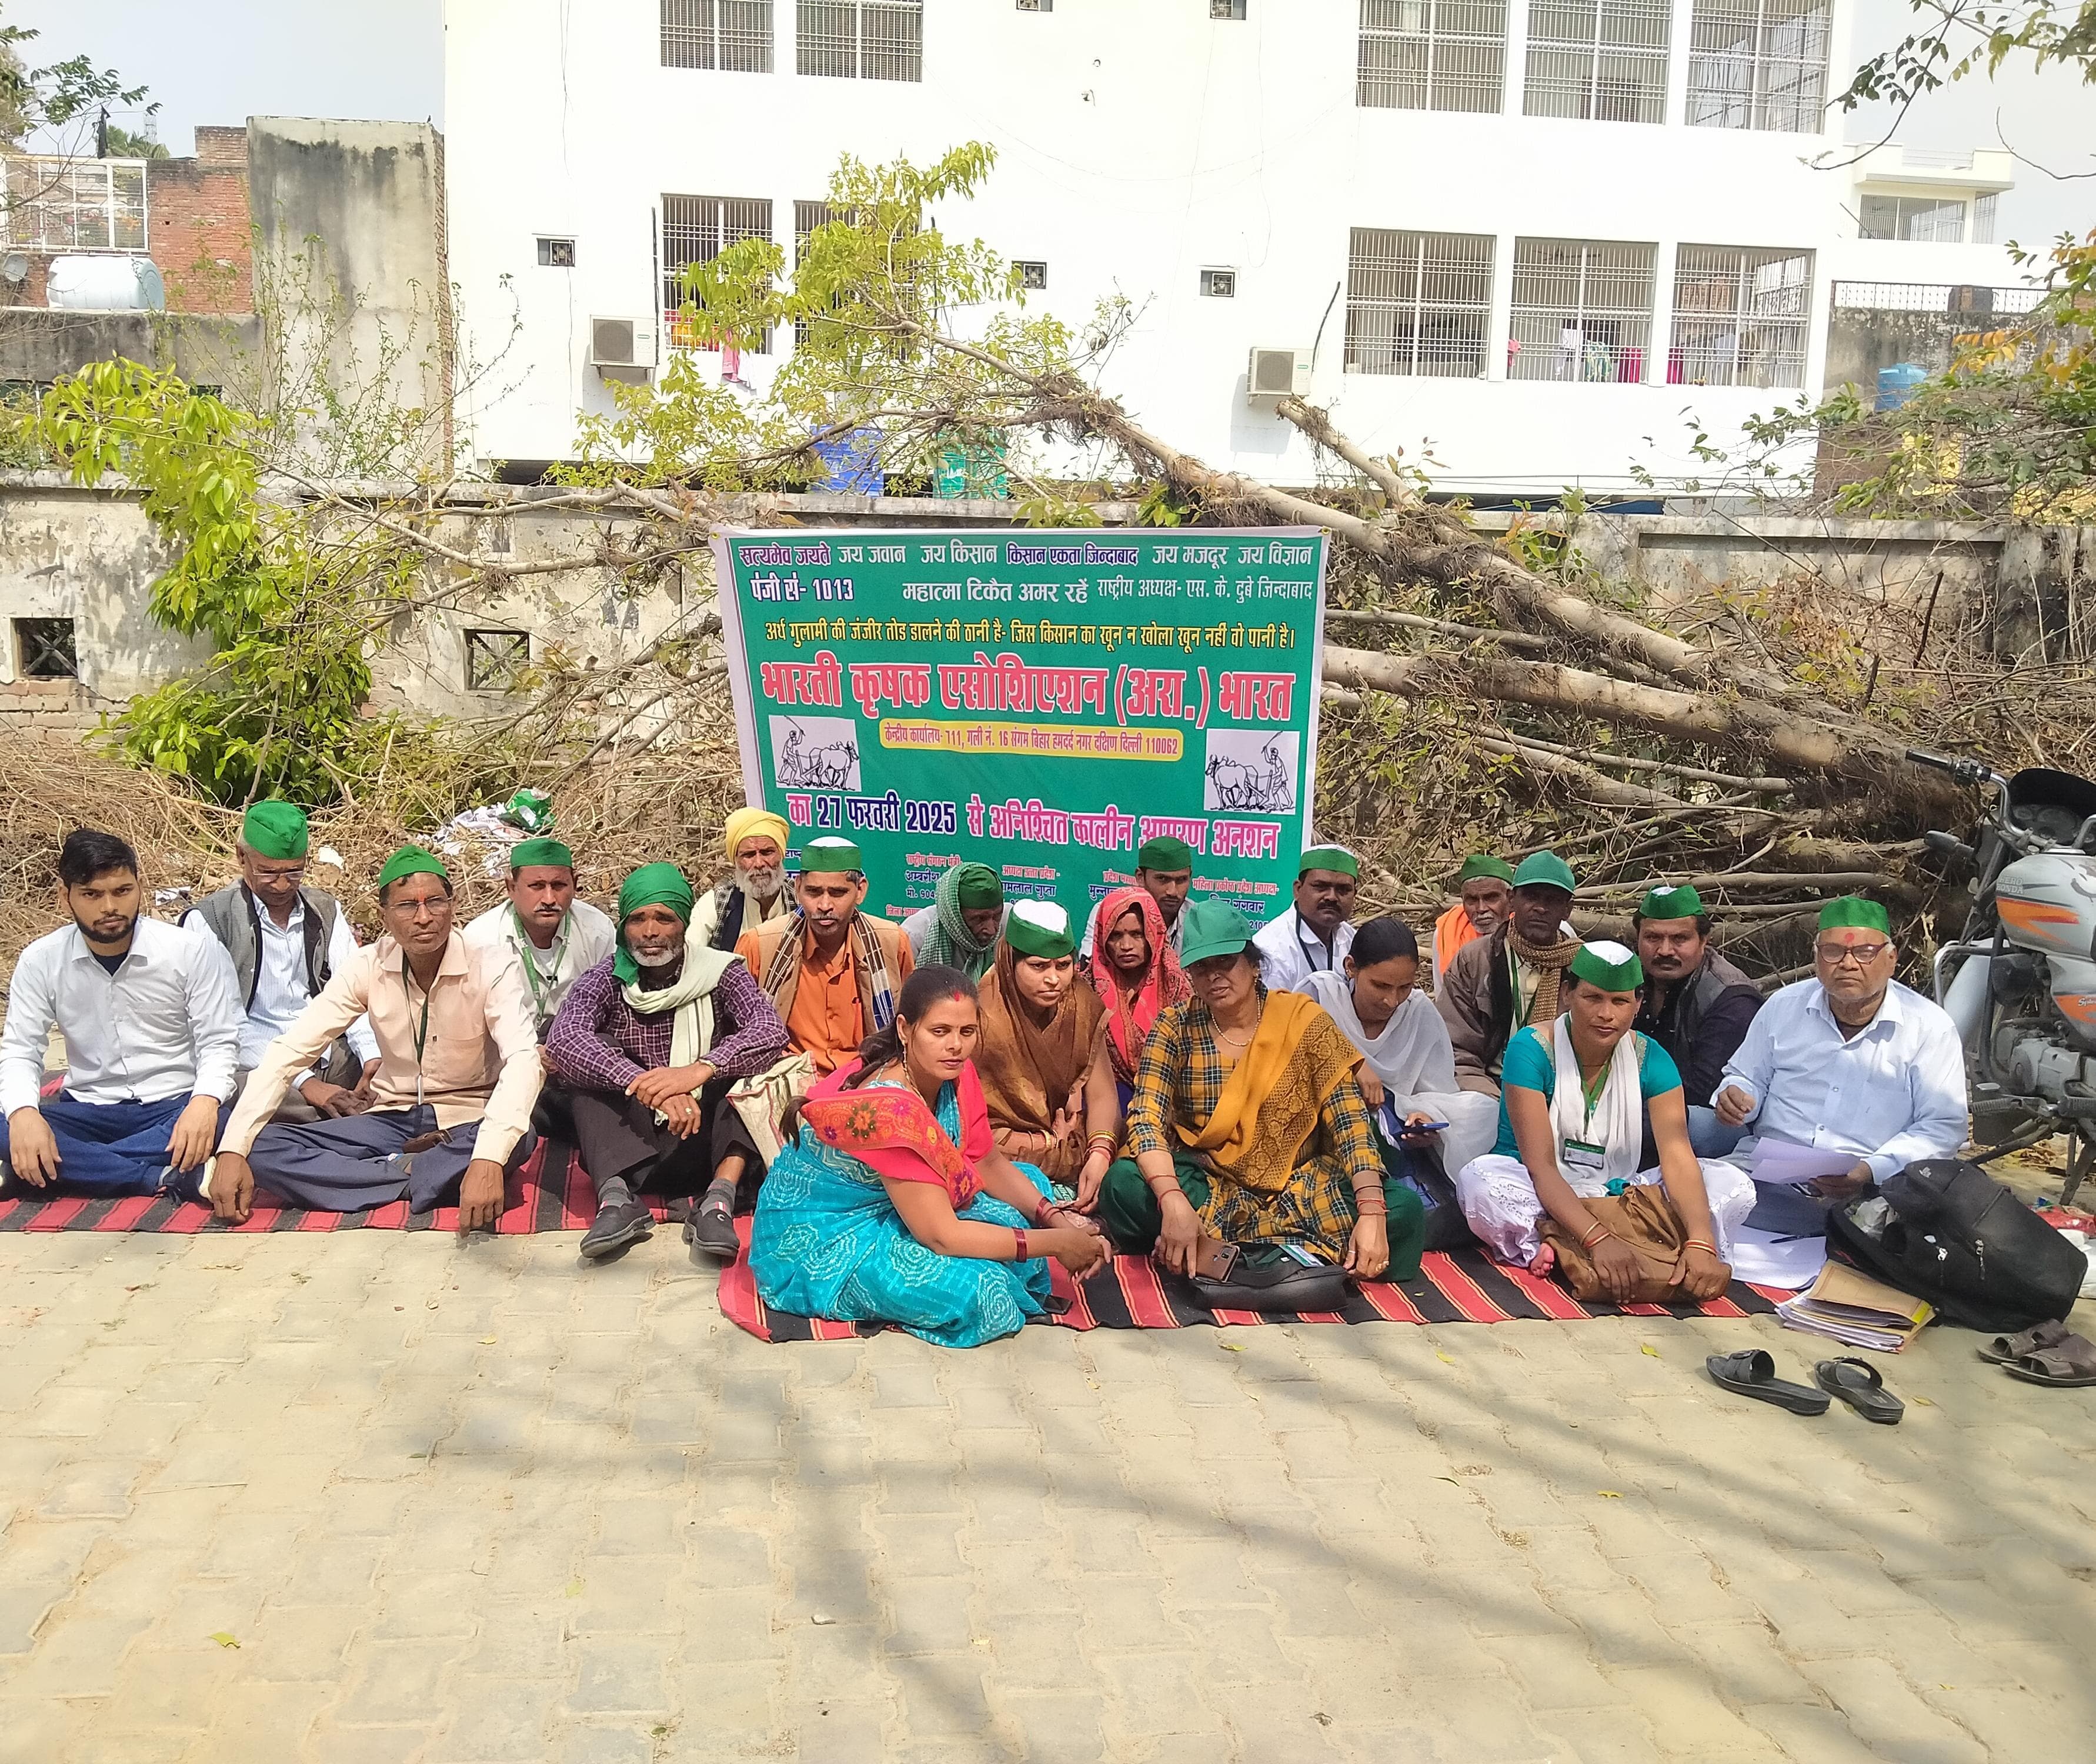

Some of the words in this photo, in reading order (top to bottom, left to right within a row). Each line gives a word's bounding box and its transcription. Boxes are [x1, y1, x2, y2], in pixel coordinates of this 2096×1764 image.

[739, 542, 792, 567] सत्यमेव
[794, 541, 831, 567] जयते
[837, 546, 863, 563] जय
[867, 546, 906, 563] जवान
[920, 546, 946, 563] जय
[950, 539, 997, 564] किसान
[1006, 541, 1046, 565] किसान
[1049, 547, 1082, 564] एकता
[1084, 541, 1139, 566] जिन्दाबाद
[1153, 546, 1179, 563] जय
[1183, 546, 1229, 569] मजदूर
[1238, 547, 1264, 564] जय
[1269, 541, 1313, 566] विज्ञान
[750, 571, 781, 601] पंजी
[812, 578, 854, 600] 1013
[902, 583, 962, 602] महात्मा
[967, 577, 1013, 602] टिकैत
[1018, 584, 1060, 602] अमर
[1064, 578, 1089, 603] रहें
[1097, 574, 1134, 600] राष्ट्रीय
[1186, 580, 1210, 597] एस.
[1214, 576, 1230, 598] के.
[1235, 576, 1254, 603] दुबे
[1257, 576, 1313, 600] जिन्दाबाद
[789, 617, 828, 647] गुलामी
[830, 617, 846, 640] की
[849, 617, 883, 640] जंजीर
[885, 617, 907, 641] तोड
[909, 617, 942, 642] डालने
[944, 618, 961, 642] की
[963, 618, 990, 642] ठानी
[1010, 619, 1037, 643] जिस
[1039, 619, 1078, 644] किसान
[1080, 626, 1096, 644] का
[1099, 626, 1123, 652] खून
[1126, 626, 1137, 645] न
[1140, 620, 1174, 646] खोला
[1177, 627, 1201, 653] खून
[1230, 622, 1245, 647] वो
[1248, 623, 1276, 648] पानी
[760, 650, 843, 707] भारती
[848, 662, 931, 719] कृषक
[937, 651, 1109, 714] एसोशिएशन
[1114, 664, 1210, 729] (अरा.)
[1219, 671, 1296, 721] भारत
[884, 722, 908, 743] केन्द्रीय
[966, 726, 983, 747] गली
[999, 730, 1008, 747] 16
[1010, 727, 1029, 747] संगम
[1031, 729, 1051, 749] बिहार
[1052, 729, 1074, 750] हमदर्द
[1076, 734, 1092, 751] नगर
[1094, 730, 1118, 752] दक्षिण
[1120, 731, 1143, 753] दिल्ली
[1145, 737, 1178, 754] 110062
[786, 793, 812, 827] का
[817, 795, 842, 828] 27
[845, 789, 902, 831] फरवरी
[905, 800, 957, 835] 2025
[966, 793, 985, 836] से
[989, 798, 1070, 844] अनिश्चित
[1070, 804, 1135, 851] कालीन
[1212, 819, 1281, 860] अनशन
[1034, 884, 1056, 900] गुप्ता
[1997, 884, 2023, 894] HONDA
[2000, 876, 2023, 885] HERO
[1233, 894, 1265, 914] गंगवार
